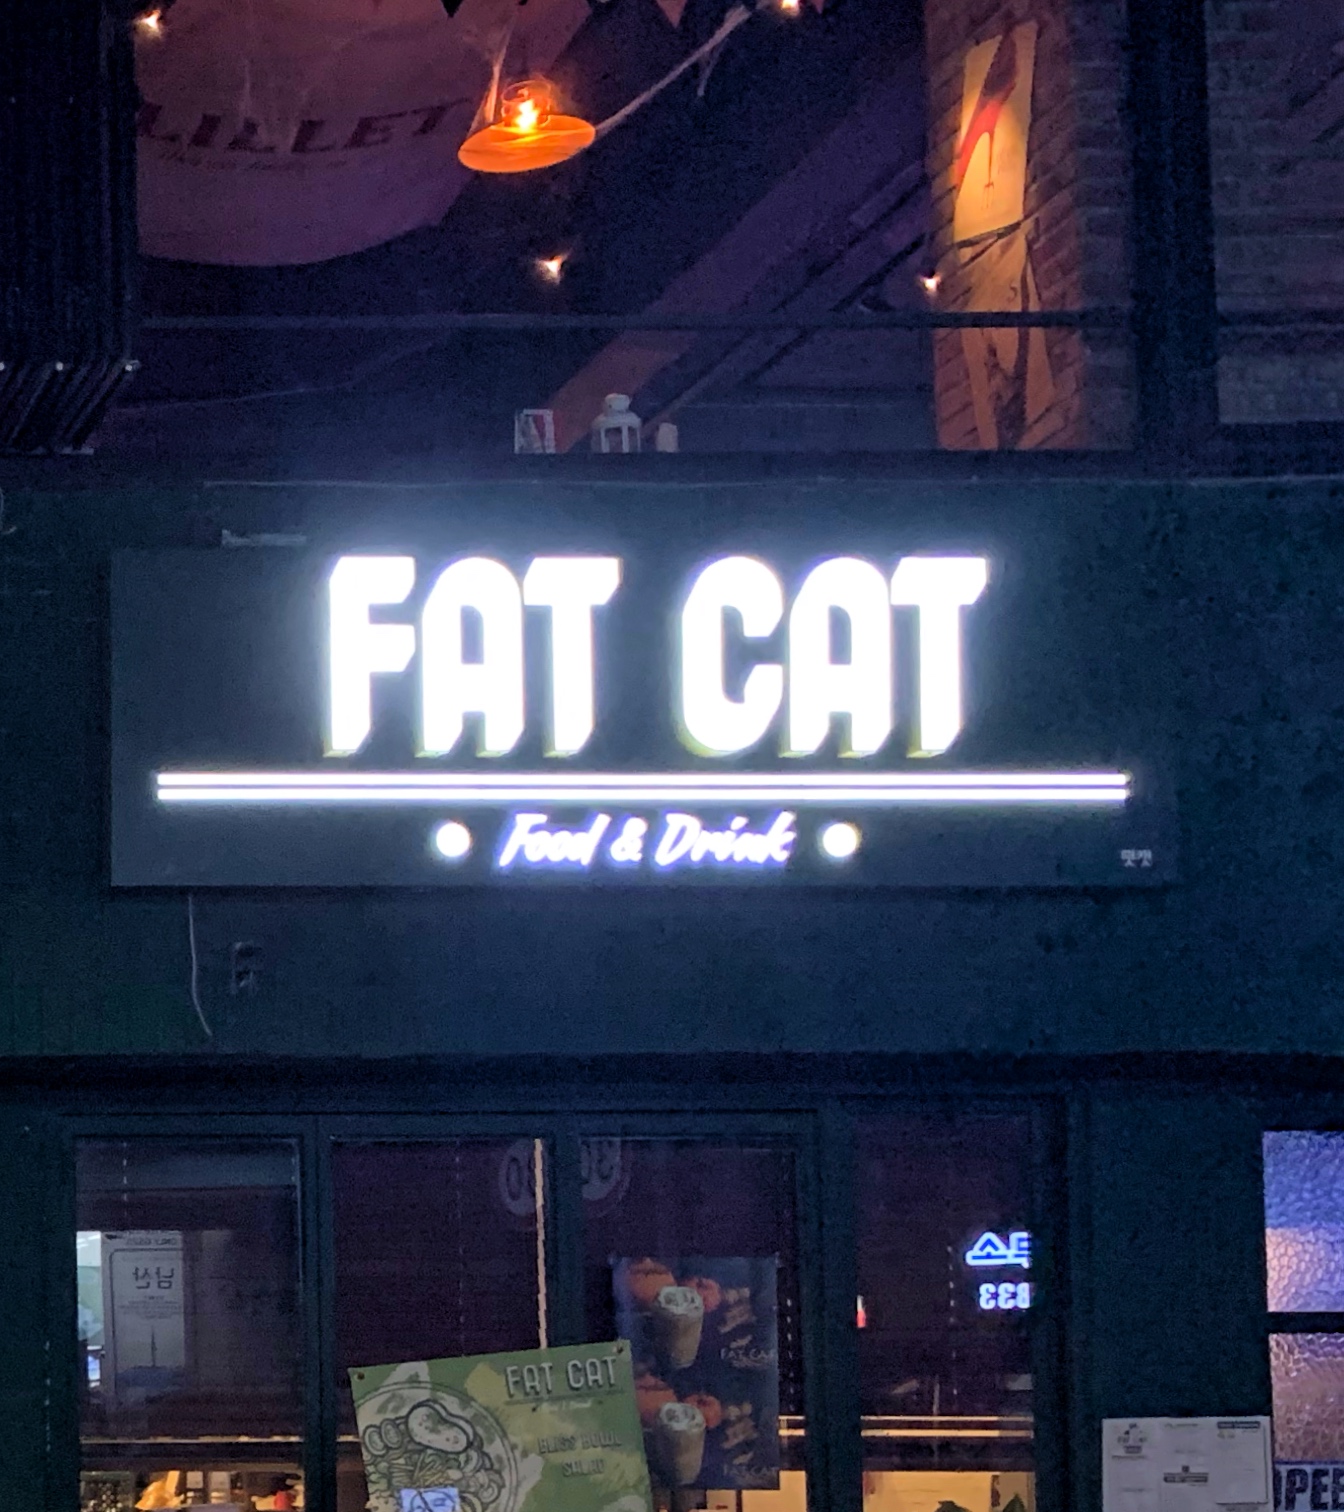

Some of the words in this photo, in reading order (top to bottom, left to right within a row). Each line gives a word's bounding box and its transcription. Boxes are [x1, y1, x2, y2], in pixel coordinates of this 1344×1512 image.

[137, 98, 471, 154] LILLET
[324, 555, 620, 757] FAT
[678, 555, 989, 757] CAT
[498, 811, 611, 867] Food
[611, 816, 648, 863] &
[654, 811, 796, 867] Drink
[505, 1362, 553, 1398] FAT
[566, 1356, 617, 1391] CAT
